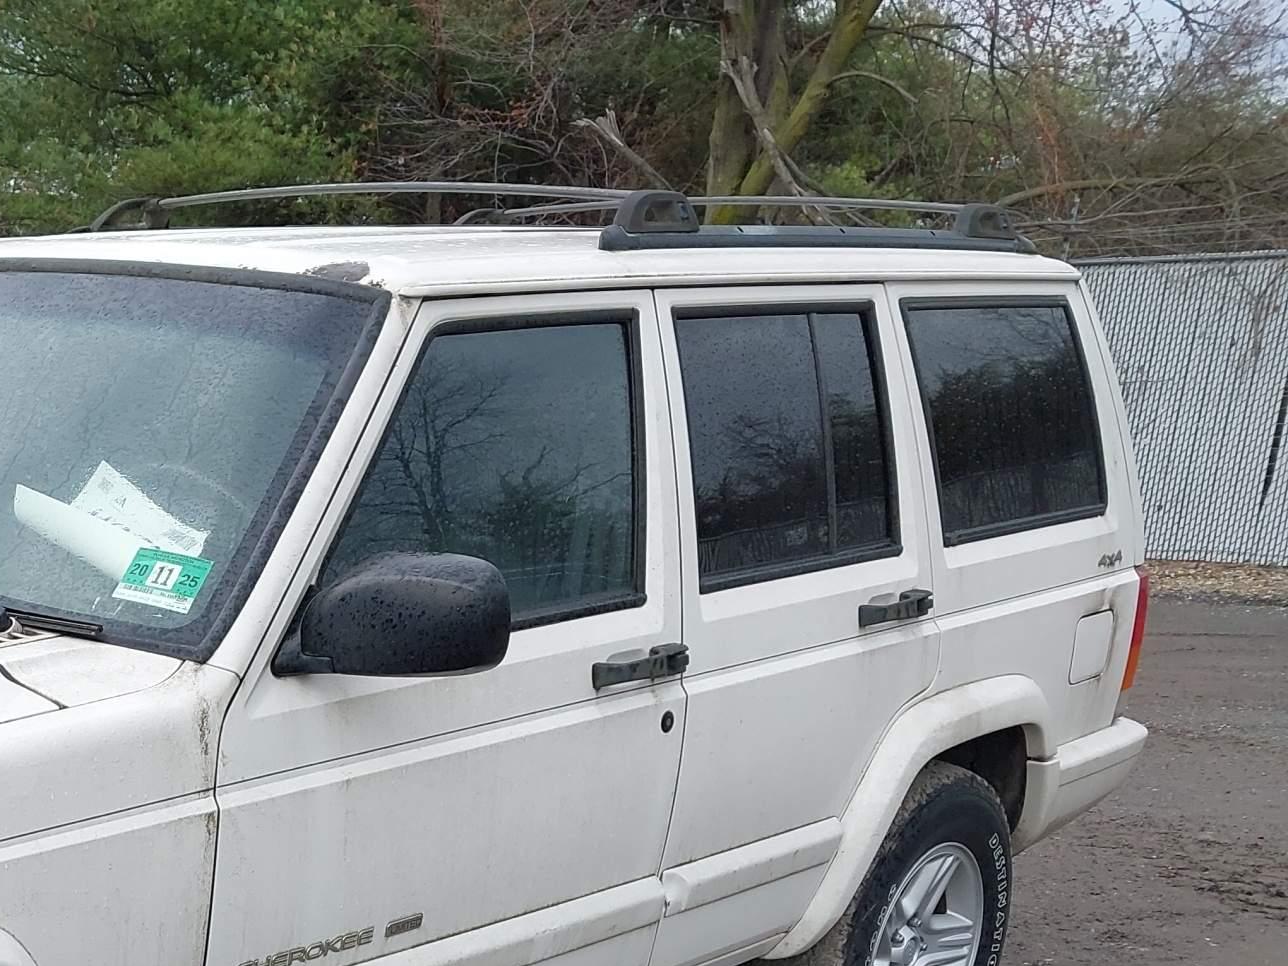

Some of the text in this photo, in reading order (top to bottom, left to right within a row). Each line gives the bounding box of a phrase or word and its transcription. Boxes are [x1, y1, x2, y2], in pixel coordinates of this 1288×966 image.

[128, 562, 201, 588] 20 11 25
